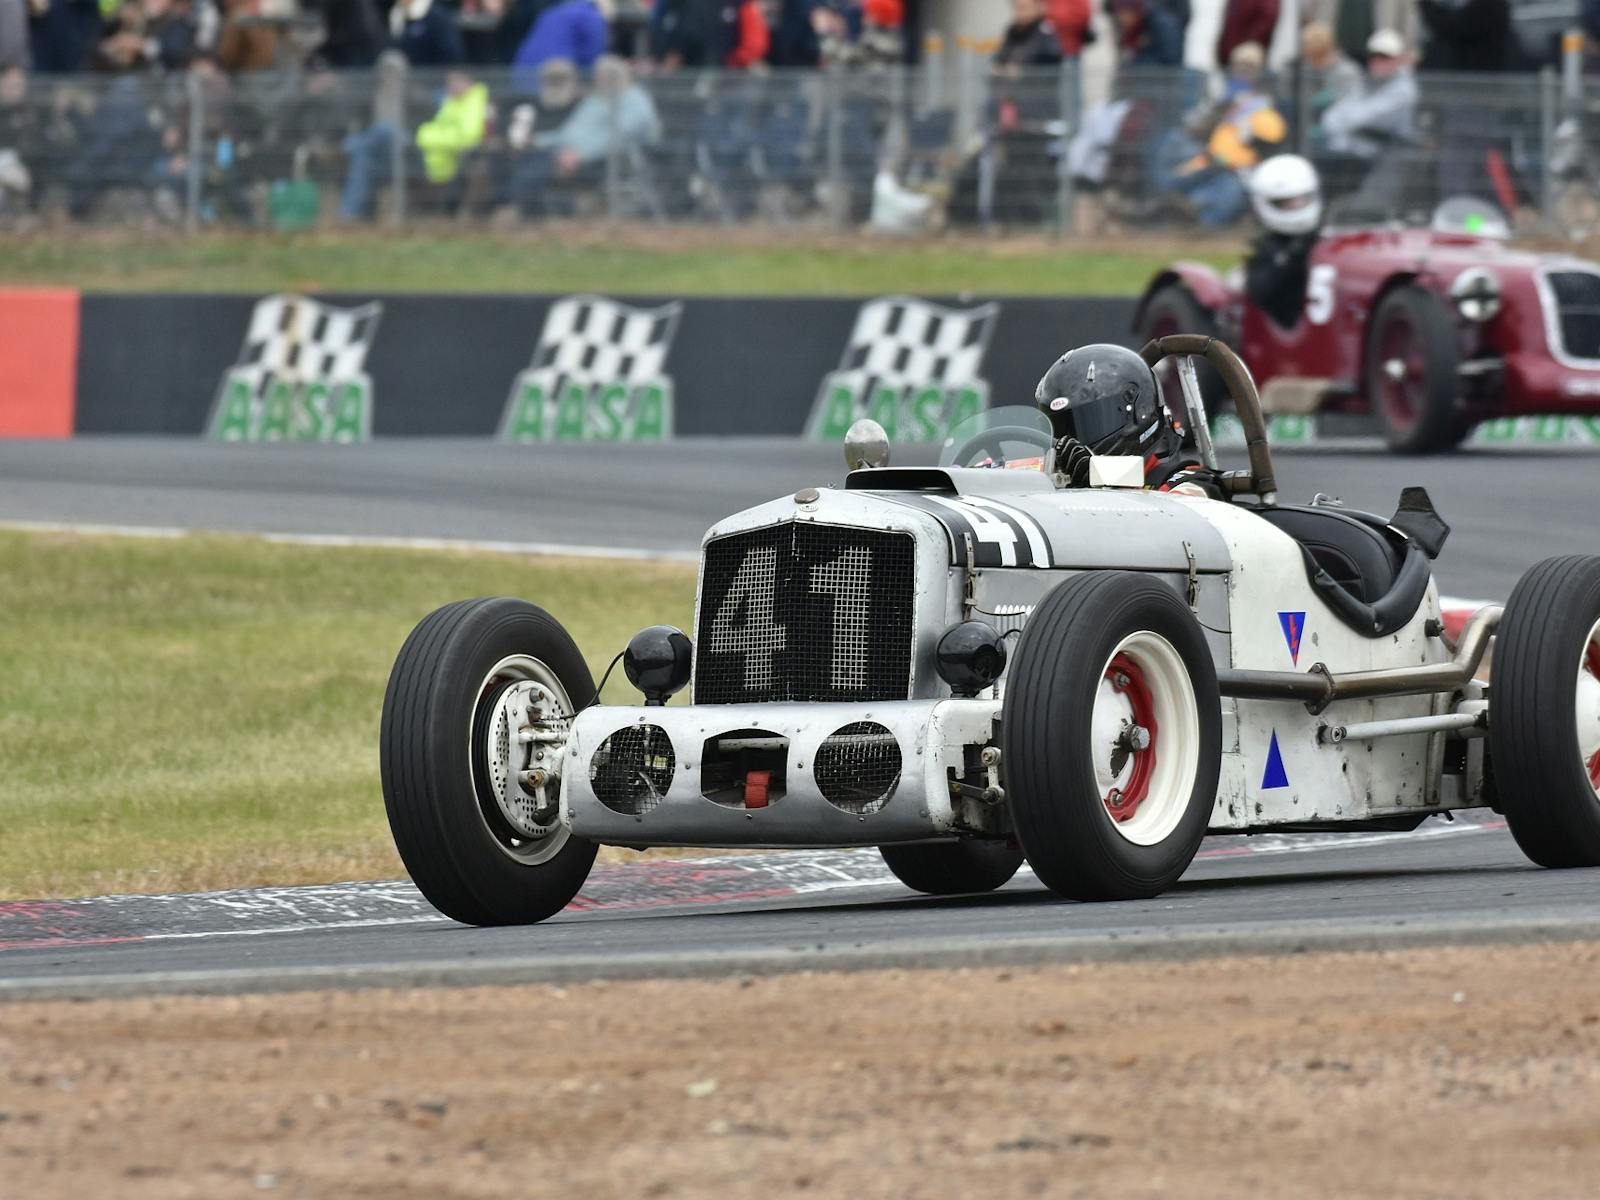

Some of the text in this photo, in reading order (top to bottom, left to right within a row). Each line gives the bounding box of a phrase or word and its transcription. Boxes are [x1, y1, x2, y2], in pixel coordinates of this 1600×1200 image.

[216, 383, 364, 442] AASA
[511, 384, 663, 440] AASA
[709, 545, 873, 690] 41
